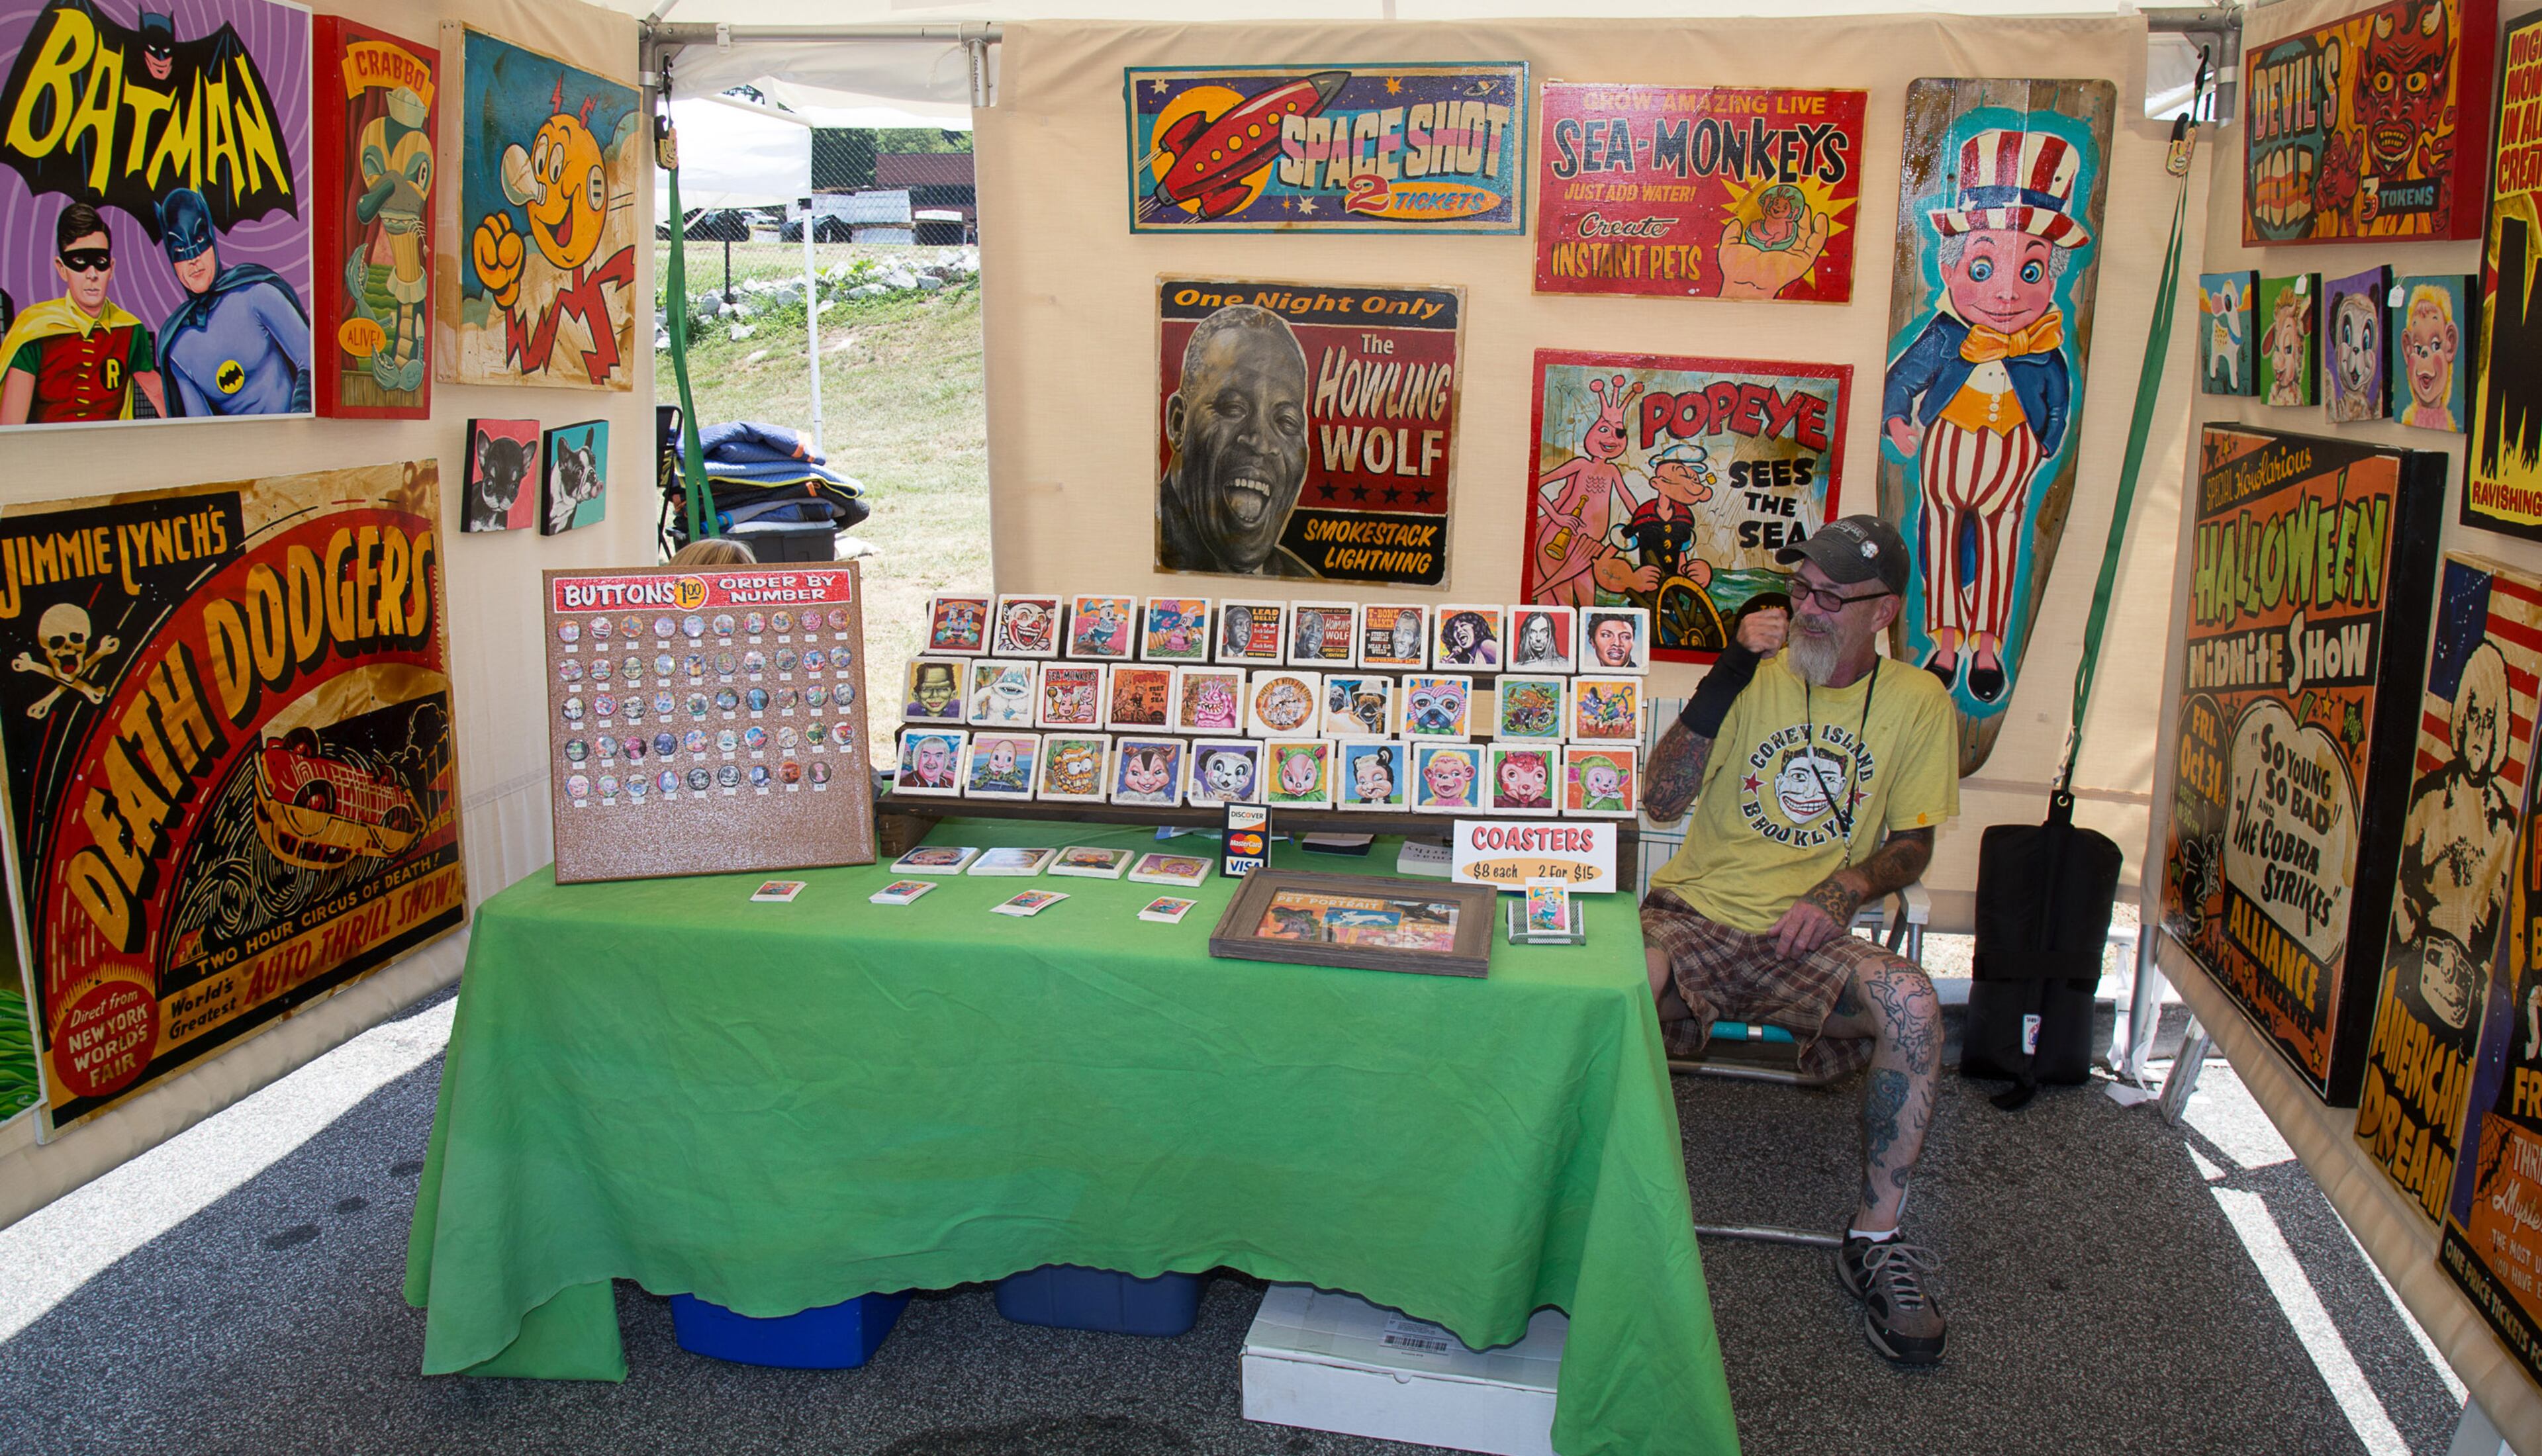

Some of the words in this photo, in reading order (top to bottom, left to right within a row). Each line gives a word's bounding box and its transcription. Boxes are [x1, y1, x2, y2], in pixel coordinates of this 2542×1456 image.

[355, 50, 425, 92] CRABBO
[2253, 36, 2339, 141] DEVIL'S
[5, 9, 290, 208] BATMAN
[1583, 92, 1652, 111] GROW
[1662, 95, 1768, 114] AMAZING
[1777, 96, 1826, 114] LIVE
[1278, 107, 1404, 189] SPACE
[1403, 101, 1510, 180] SHOT
[2502, 105, 2521, 148] IN
[1345, 173, 1390, 213] 2
[1393, 192, 1485, 212] TICKETS
[1564, 183, 1605, 201] JUST
[1607, 185, 1638, 201] ADD
[1642, 185, 1697, 202] WATER!
[2255, 145, 2314, 229] HOLE
[2362, 176, 2380, 221] 3
[2380, 185, 2434, 208] TOKENS
[1578, 212, 1678, 238] Create
[1551, 241, 1646, 278] INSTANT
[1649, 244, 1702, 280] PETS
[1174, 289, 1243, 307] One
[1250, 292, 1354, 314] Night
[1361, 296, 1444, 319] Only
[347, 328, 380, 346] ALIVE!
[1361, 334, 1394, 354] The
[1313, 345, 1451, 421] HOWLING
[1640, 381, 1828, 454] POPEYE
[1320, 425, 1444, 477] WOLF
[1728, 458, 1815, 488] SEES
[2206, 468, 2233, 512] SPECIAL
[1744, 492, 1797, 518] THE
[2472, 480, 2542, 516] RAVISHING
[1304, 519, 1437, 547] SMOKESTACK
[1738, 521, 1808, 549] SEA
[0, 527, 111, 619] JIMMIE
[117, 505, 227, 595] LYNCH'S
[1325, 547, 1432, 574] LIGHTNING
[564, 582, 675, 607] BUTTONS
[718, 576, 796, 590] ORDER
[807, 575, 835, 588] BY
[731, 589, 825, 603] NUMBER
[203, 526, 433, 720] DODGERS
[1368, 609, 1399, 619] T-BONE
[1325, 631, 1349, 640] WOLF
[1063, 670, 1097, 680] MONKEYS
[2192, 704, 2217, 749] FRI.
[1750, 724, 1812, 770] CONEY
[1821, 724, 1874, 783] ISLAND
[67, 641, 215, 952] DEATH
[2257, 797, 2275, 820] AND
[2265, 768, 2290, 815] SO
[1231, 811, 1264, 819] DISCOVER
[1741, 799, 1856, 847] BROOKLYN
[1229, 839, 1261, 848] MasterCard
[1472, 826, 1594, 852] COASTERS
[2259, 819, 2321, 878] COBRA
[1474, 862, 1490, 880] $8
[1493, 864, 1518, 878] each
[1538, 865, 1546, 878] 2
[1574, 864, 1594, 882] $15
[197, 946, 238, 975] TWO
[246, 921, 293, 954] HOUR
[302, 895, 357, 927] CIRCUS
[363, 883, 381, 899] OF
[385, 852, 440, 887] DEATH!
[1276, 896, 1303, 905] PET
[1309, 897, 1380, 909] PORTRAIT
[246, 942, 310, 1005] AUTO
[320, 902, 391, 967] THRILL
[398, 868, 457, 926] SHOW!
[2229, 893, 2319, 1013] ALLIANCE
[70, 999, 107, 1028] Direct
[109, 990, 138, 1010] from
[171, 977, 234, 1019] World's
[69, 1023, 105, 1054] NEW
[106, 1003, 148, 1034] YORK
[169, 997, 236, 1040] Greatest
[74, 1024, 148, 1072] WORLD'S
[2371, 966, 2474, 1149] AMERICAN
[90, 1053, 137, 1087] FAIR
[2358, 1062, 2453, 1227] DREAM
[2491, 1228, 2508, 1251] THE
[2509, 1239, 2531, 1267] MOST
[2493, 1253, 2508, 1278] YOU
[2512, 1265, 2532, 1293] HAVE
[2445, 1238, 2465, 1275] ONE
[2464, 1260, 2492, 1306] PRICE
[2491, 1292, 2529, 1352] TICKETS
